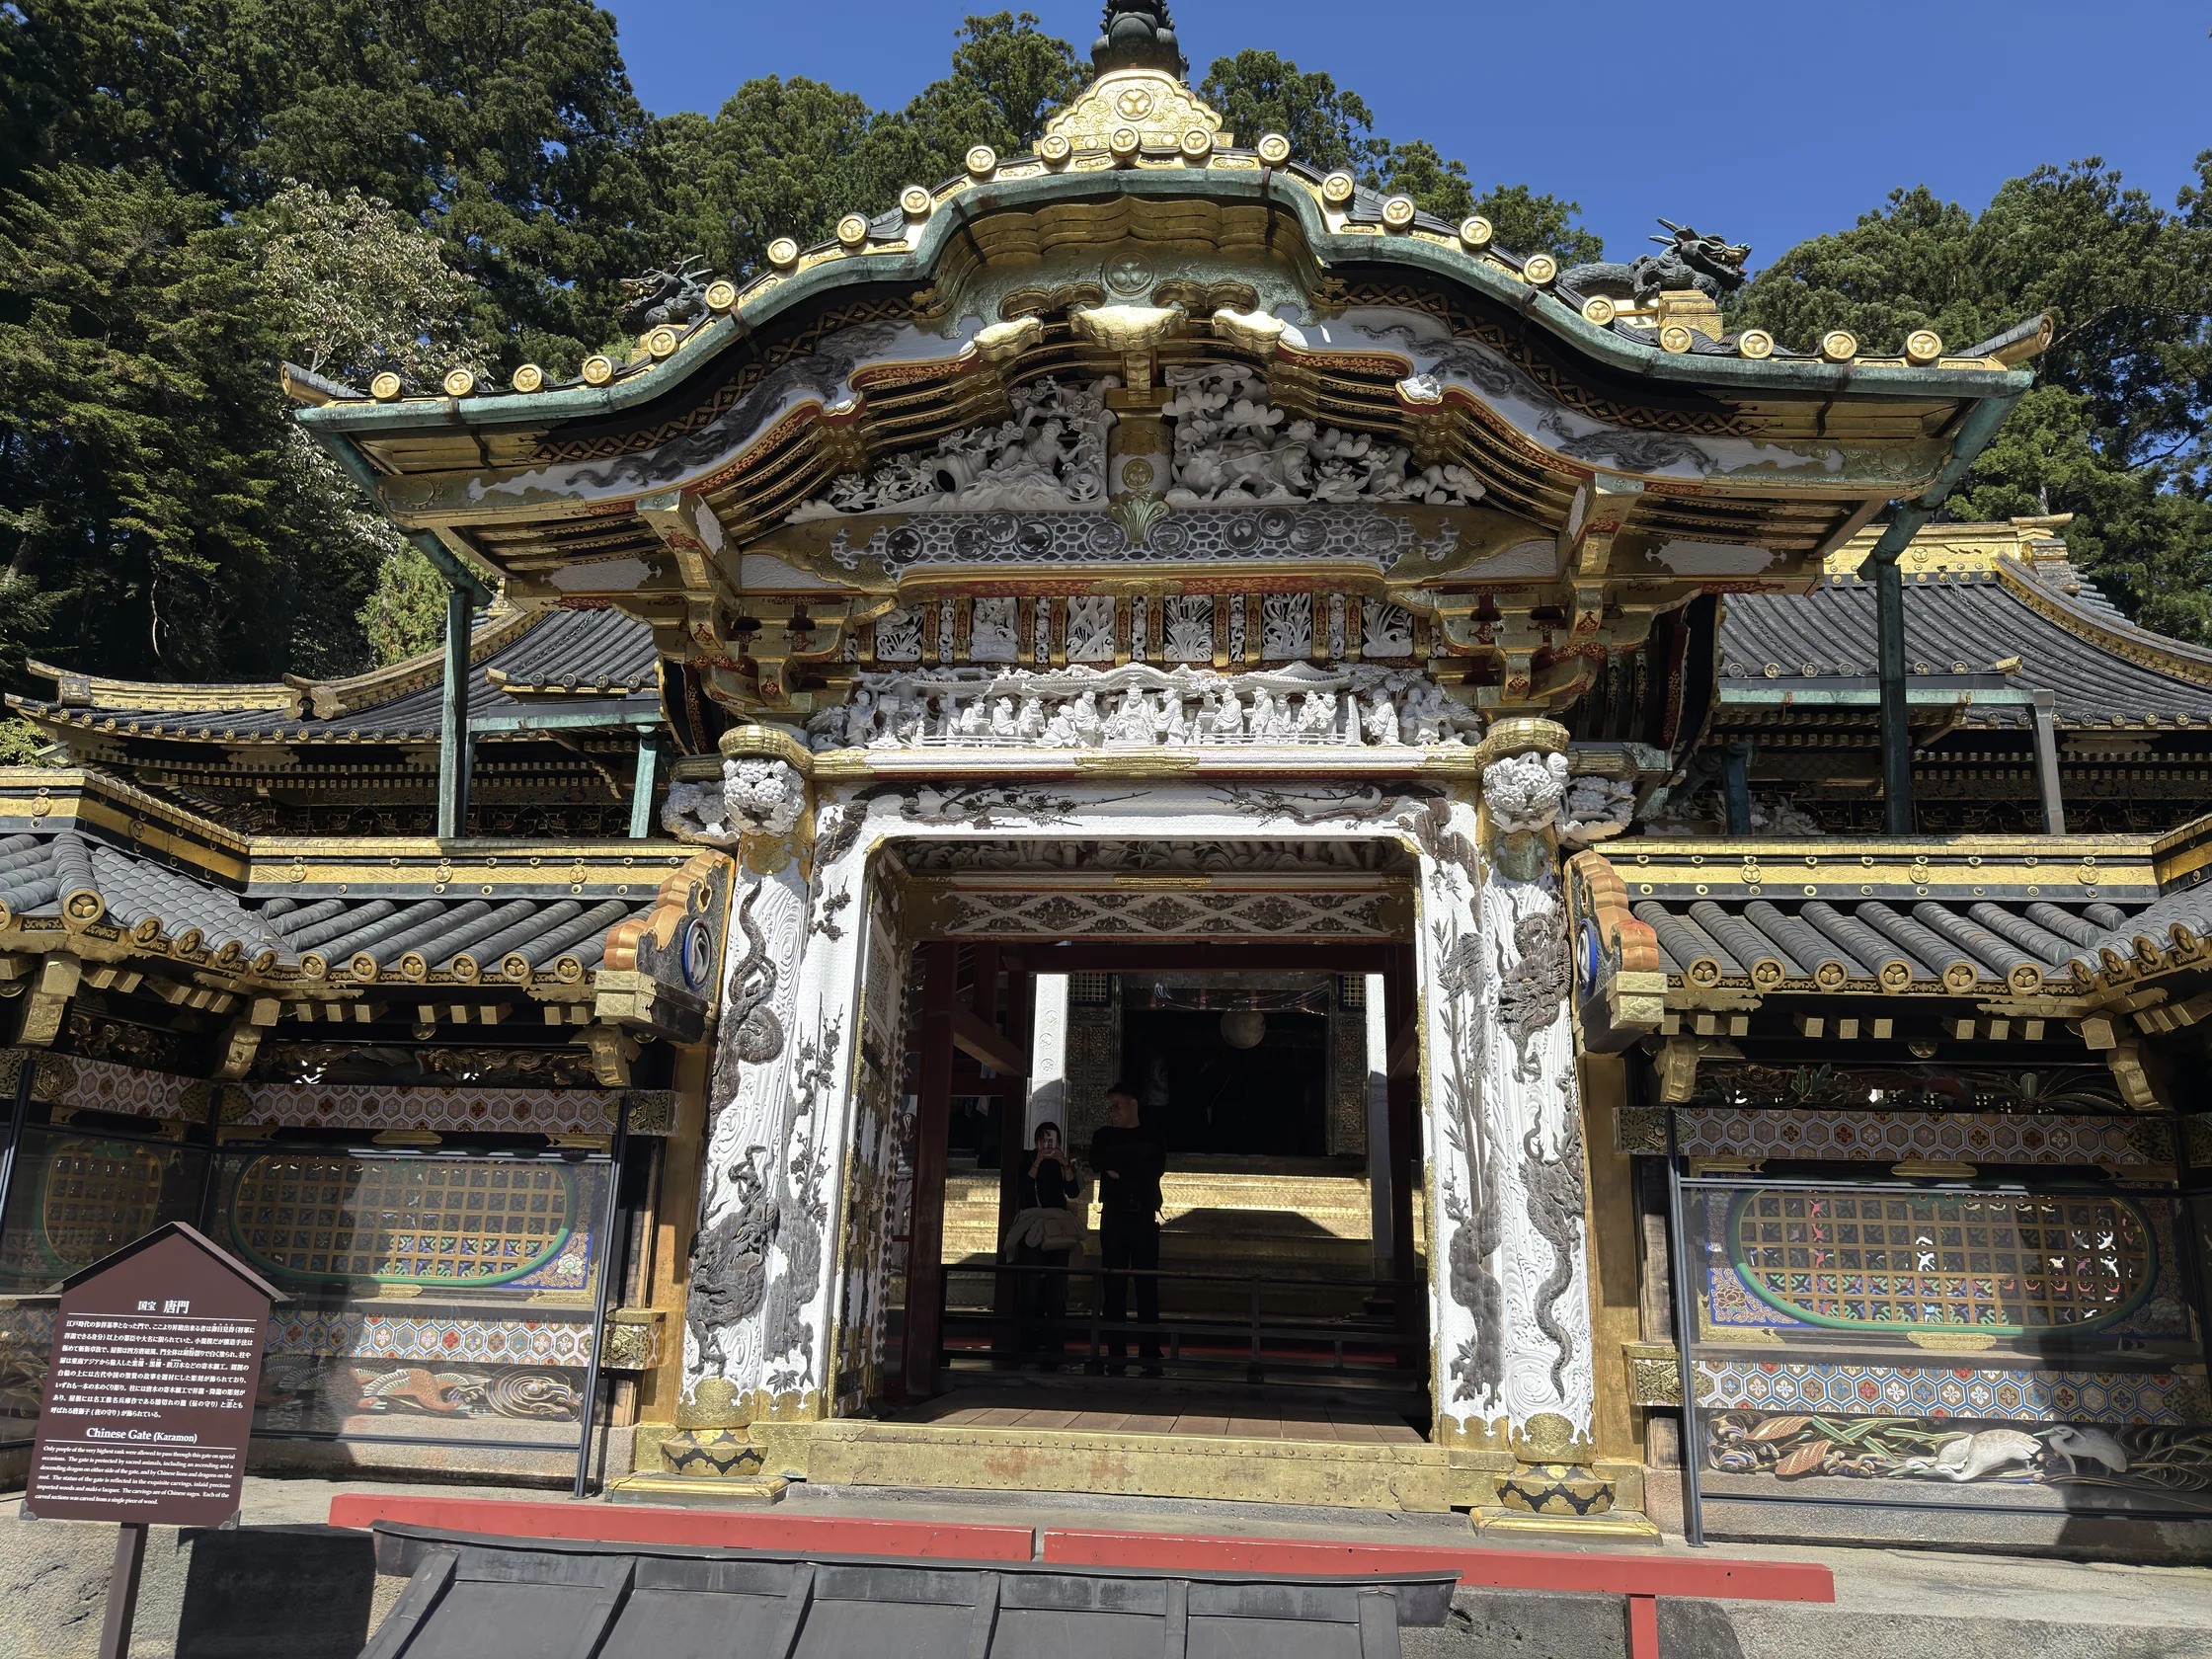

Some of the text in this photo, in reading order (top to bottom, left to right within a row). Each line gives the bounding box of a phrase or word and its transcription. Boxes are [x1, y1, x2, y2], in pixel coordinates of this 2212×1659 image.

[138, 1300, 190, 1313] 国宝 唐門
[86, 1428, 198, 1444] Chinese Gate (Karamon)
[40, 1464, 66, 1473] descending
[195, 1462, 219, 1470] ascending
